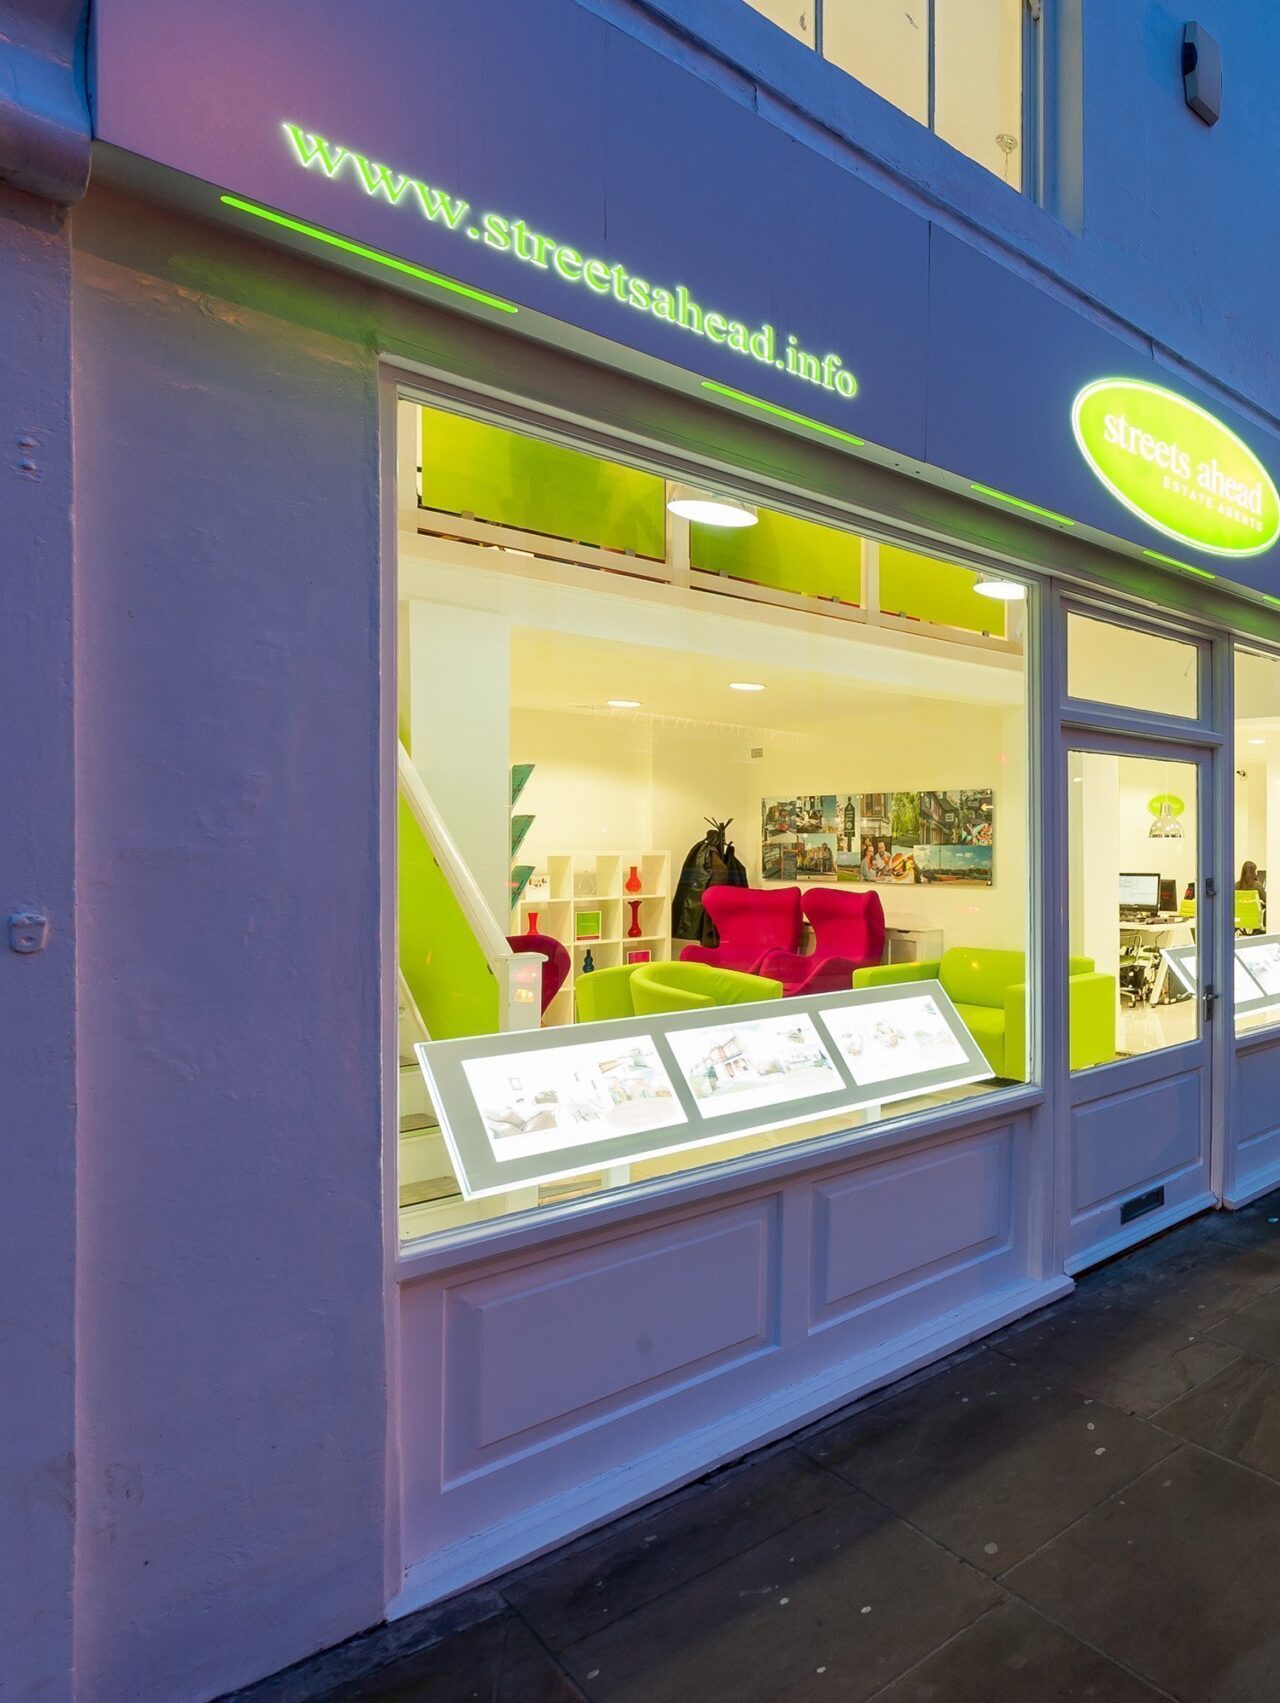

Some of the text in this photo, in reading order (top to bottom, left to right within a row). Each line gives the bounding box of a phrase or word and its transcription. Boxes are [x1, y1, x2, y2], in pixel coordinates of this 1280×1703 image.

[281, 123, 859, 399] www.streetsahead.info
[1103, 413, 1263, 515] streets ahead
[1163, 476, 1264, 533] ESTATE AGENTS
